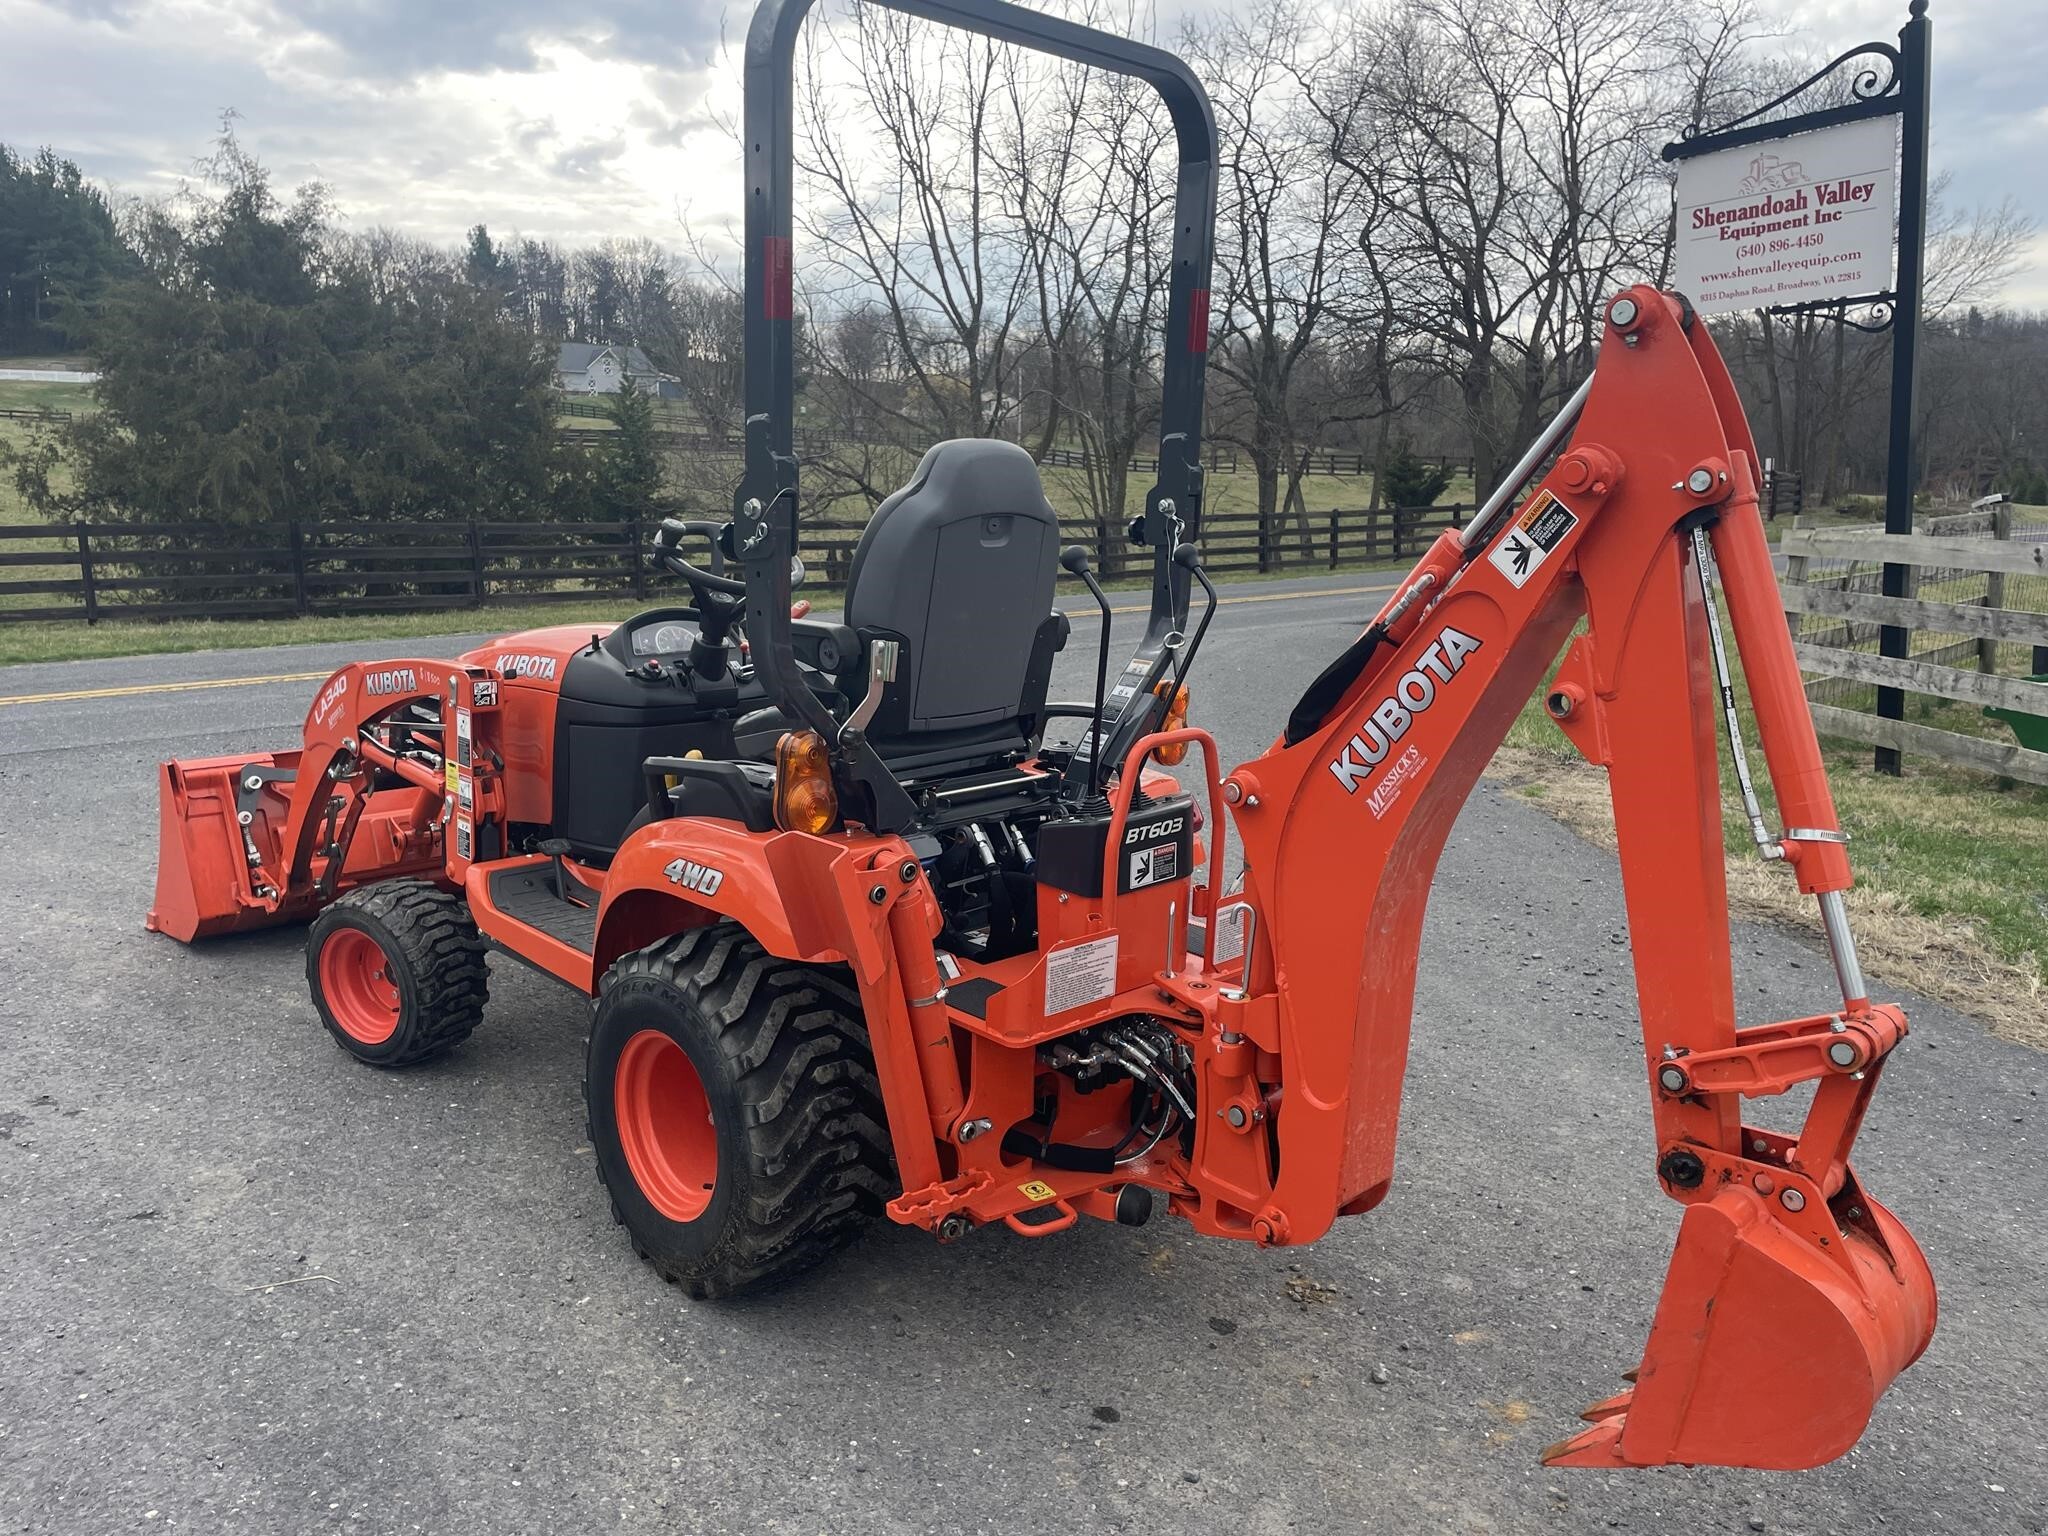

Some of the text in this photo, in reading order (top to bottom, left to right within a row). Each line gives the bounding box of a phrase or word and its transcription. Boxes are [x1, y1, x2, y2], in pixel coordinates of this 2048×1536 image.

[1692, 180, 1876, 230] Shenandoah Valley
[1719, 208, 1842, 241] Equipment Inc
[1736, 232, 1824, 260] (540) 896-4450
[1700, 251, 1862, 283] www.shenvalleyequip.com
[1718, 289, 1750, 300] Daphna
[1823, 275, 1836, 284] VA
[1837, 271, 1862, 282] 22815
[1527, 496, 1549, 522] WARNING
[366, 668, 418, 696] KUBOTA
[495, 654, 557, 681] KUBOTA
[314, 675, 347, 725] LA340
[1328, 625, 1484, 795] KUBOTA
[1365, 743, 1419, 817] MESSICK'S
[1125, 817, 1184, 845] BT603
[663, 857, 724, 897] 4WD
